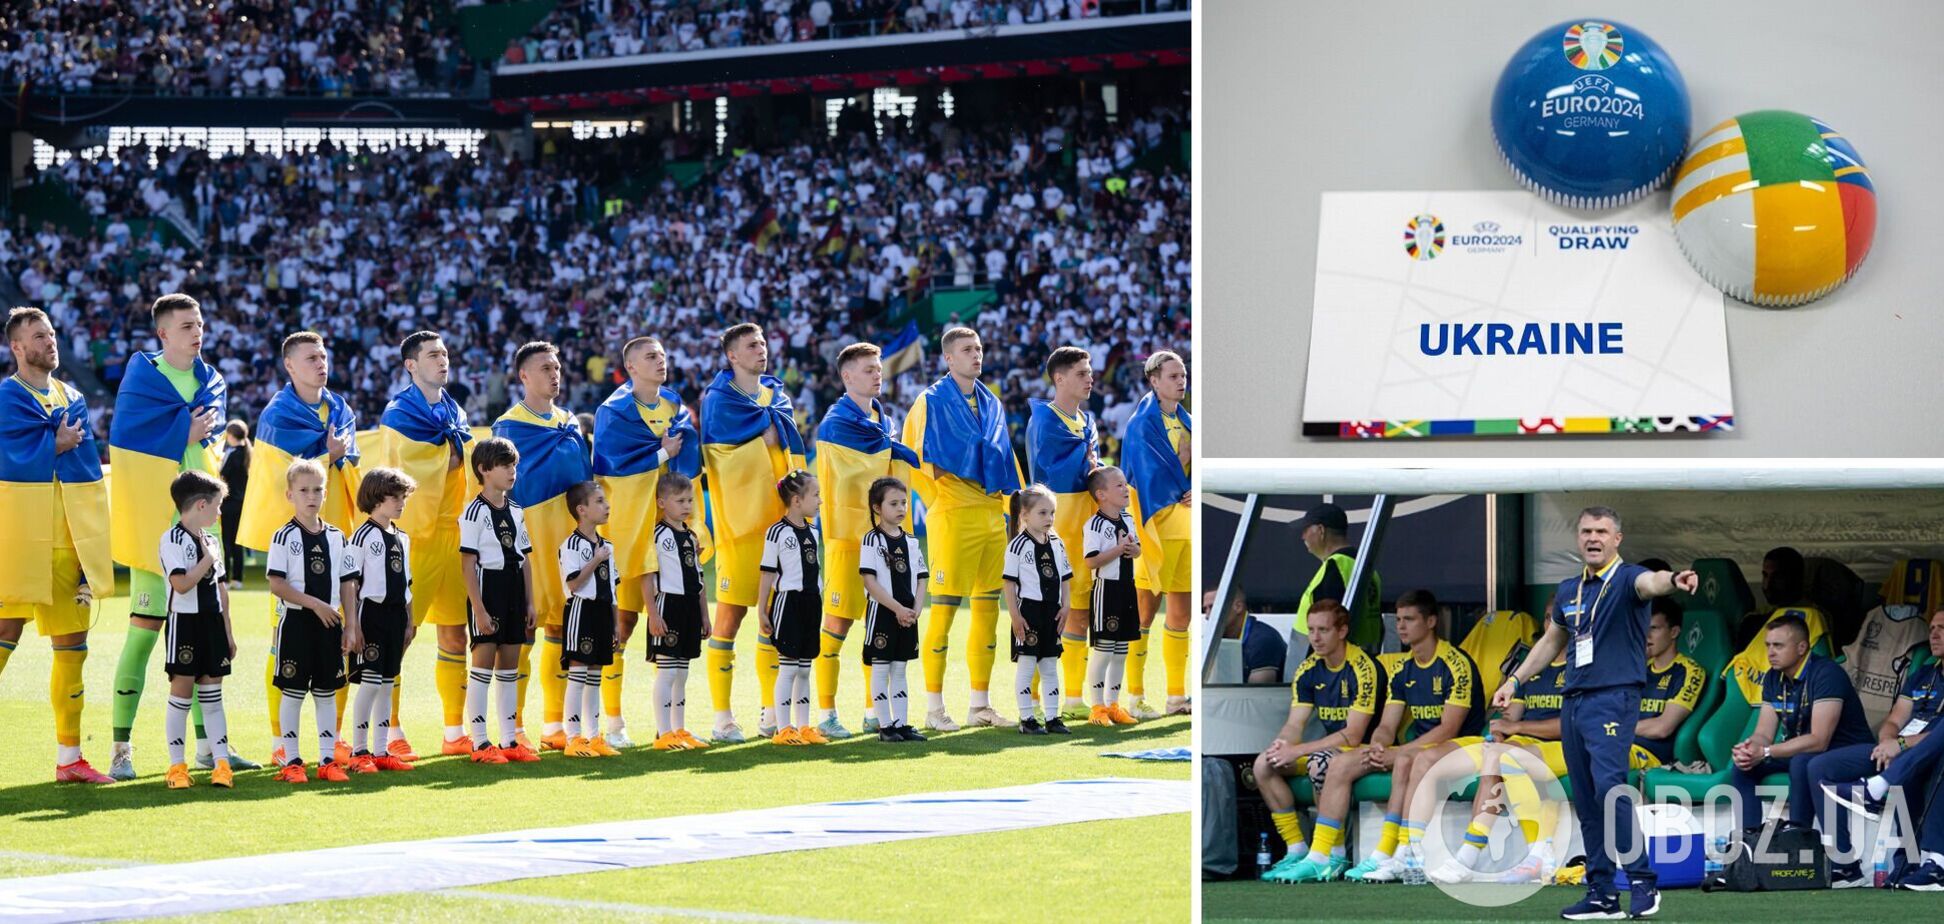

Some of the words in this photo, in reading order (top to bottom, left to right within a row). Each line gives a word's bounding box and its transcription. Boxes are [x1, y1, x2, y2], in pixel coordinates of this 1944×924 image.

[1574, 77, 1610, 92] UEFA
[1542, 95, 1644, 120] EURO2024
[1564, 116, 1620, 128] GERMANY
[1473, 221, 1502, 233] UEFA
[1548, 225, 1639, 235] QUALIFYING
[1452, 235, 1522, 246] EURO2024
[1558, 236, 1630, 250] DRAW
[1420, 322, 1624, 357] UKRAINE
[1862, 676, 1896, 694] RESPE
[1527, 694, 1564, 709] EPICENT
